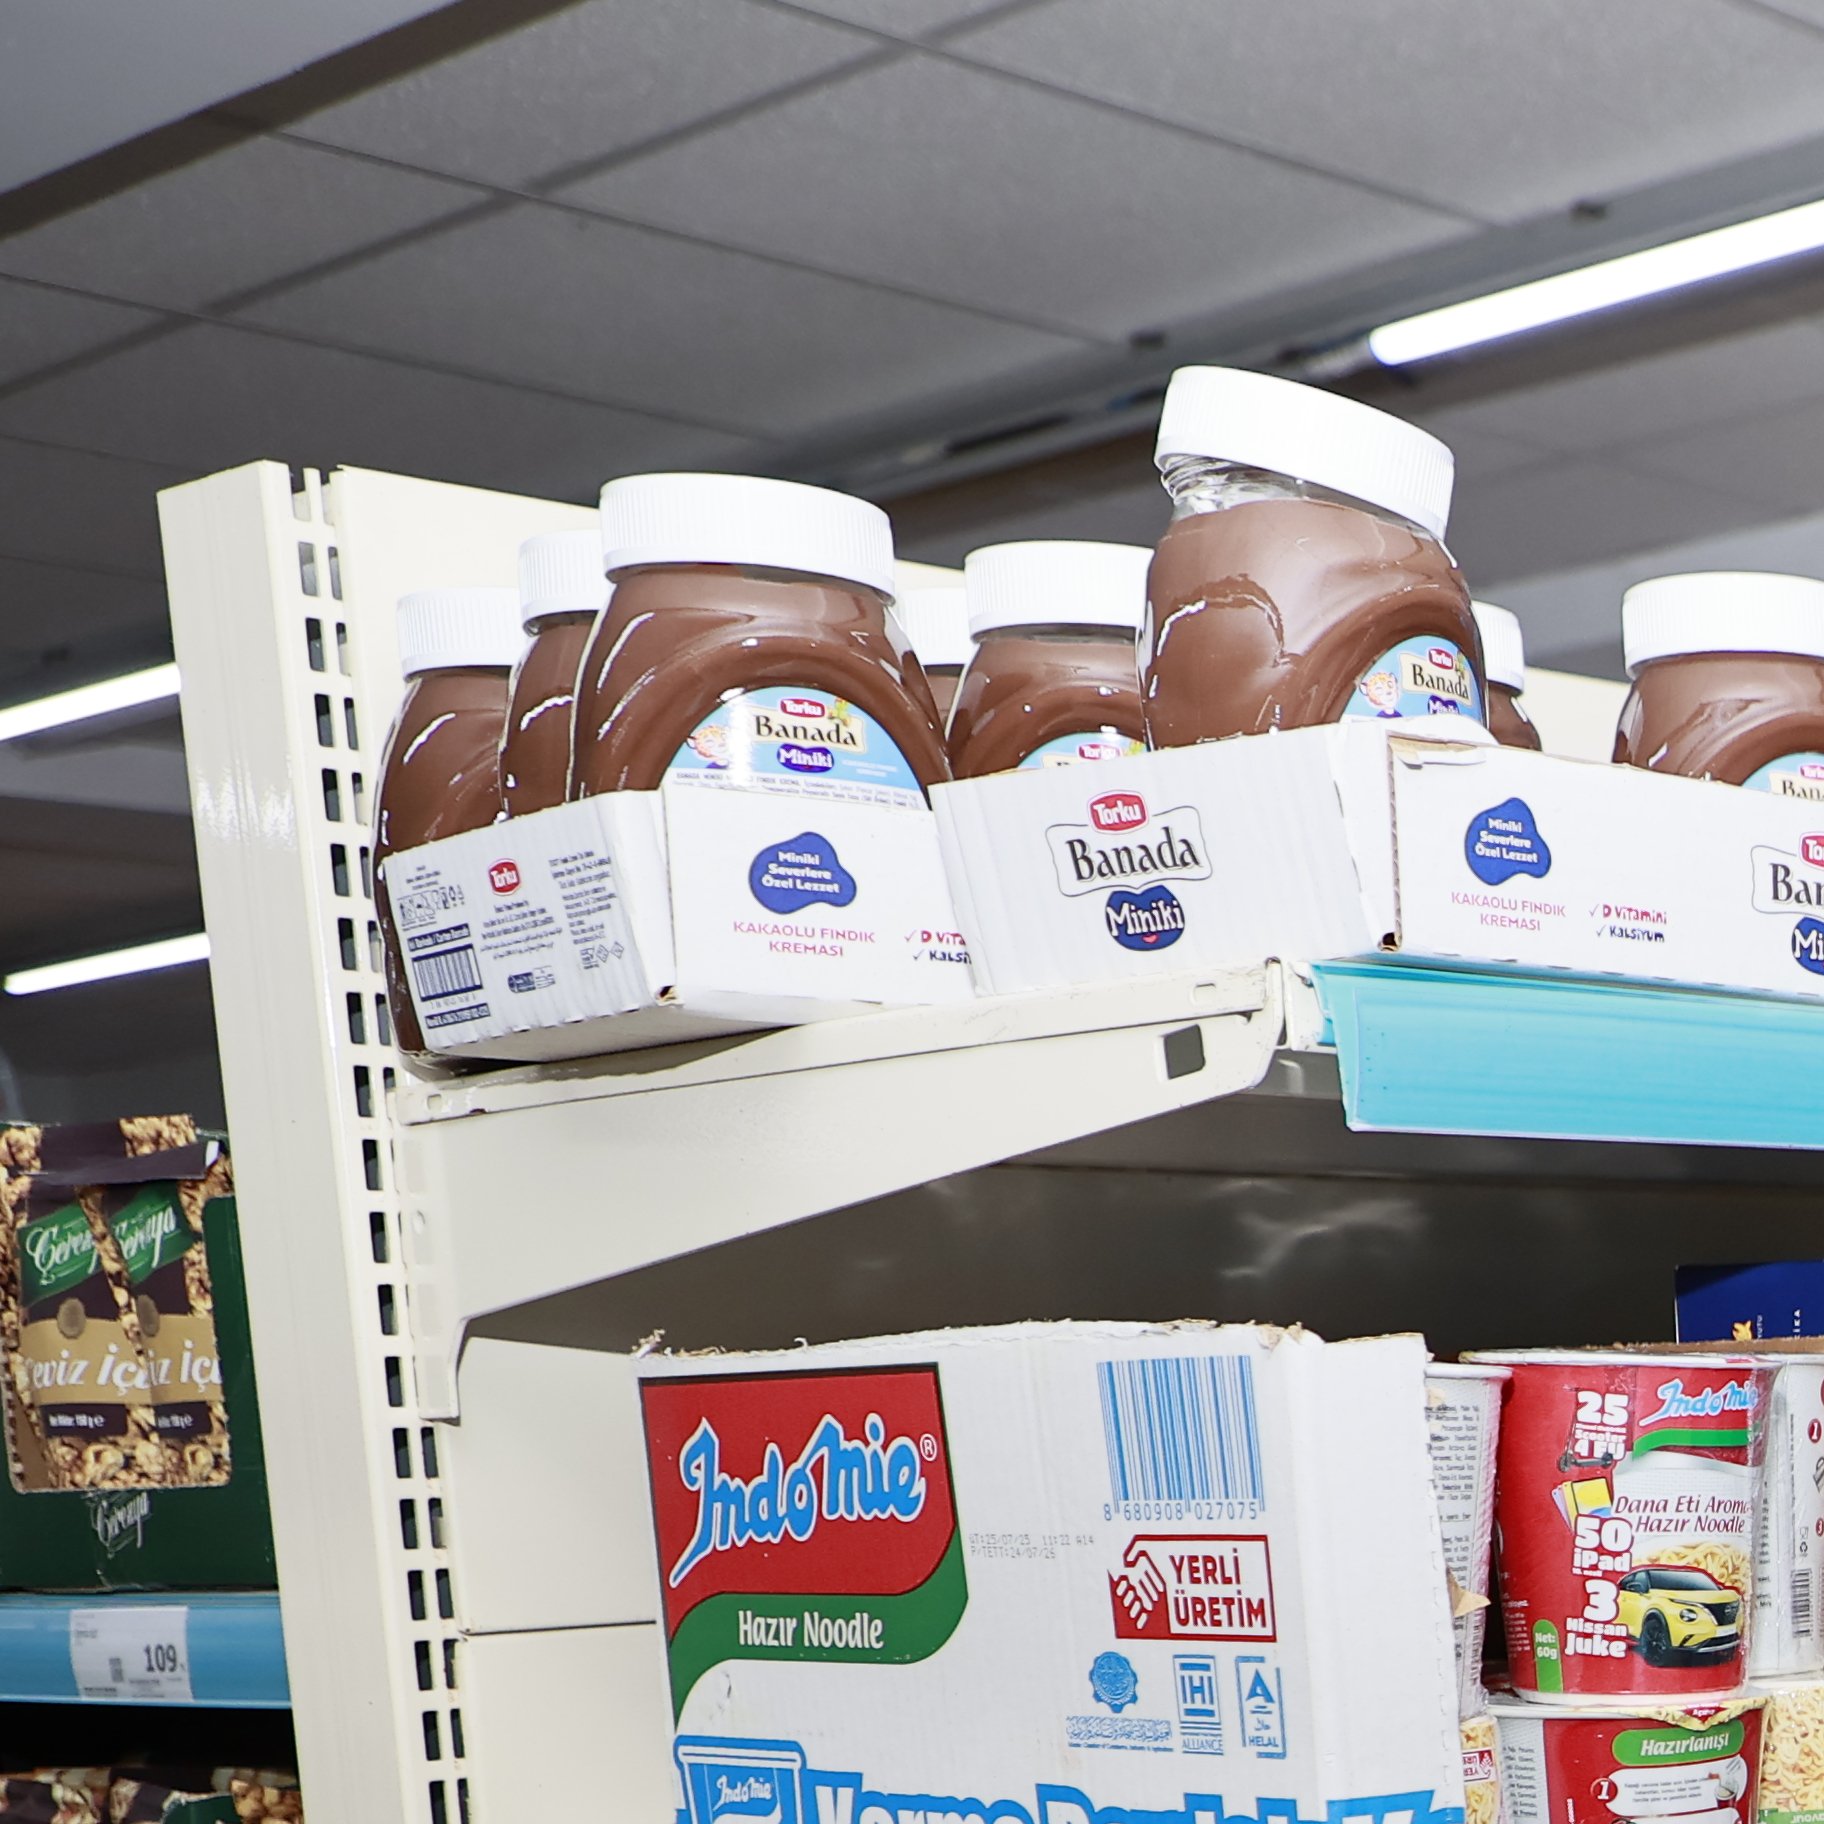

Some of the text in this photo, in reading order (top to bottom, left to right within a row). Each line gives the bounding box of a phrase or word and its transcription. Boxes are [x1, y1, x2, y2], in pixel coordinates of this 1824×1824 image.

[1411, 663, 1469, 700] Banada
[755, 715, 857, 747] Banada
[779, 748, 833, 768] Miniki
[1092, 800, 1141, 827] Torku
[778, 851, 820, 866] Miniki
[1066, 825, 1201, 882] Banada
[490, 866, 519, 889] Torku
[768, 863, 832, 881] Severlere
[795, 877, 840, 894] Lezzet
[1451, 891, 1566, 918] KAKAOLU FINDIK
[1105, 899, 1185, 937] Miniki
[1480, 913, 1541, 932] KREMASI
[733, 921, 876, 944] KAKAOLU FINDIK
[769, 941, 844, 957] KREMASI
[1577, 1391, 1629, 1426] 25
[1614, 1494, 1701, 1515] Dana Eti
[1574, 1517, 1633, 1552] 50
[1635, 1515, 1746, 1534] Hazır Noodle
[1169, 1547, 1242, 1586] YERLİ
[1573, 1549, 1631, 1573] iPad
[1173, 1589, 1267, 1628] ÜRETİM
[1584, 1580, 1620, 1622] 3
[738, 1608, 885, 1650] Hazır Noodle
[1534, 1630, 1557, 1646] Net:
[1565, 1618, 1627, 1638] Nissan
[1535, 1646, 1558, 1664] 60g
[1565, 1633, 1627, 1659] Juke
[143, 1644, 178, 1673] 109
[1181, 1737, 1224, 1751] ALLIANCE
[1247, 1733, 1281, 1748] HELAL
[1640, 1733, 1730, 1758] Hazırlanışı
